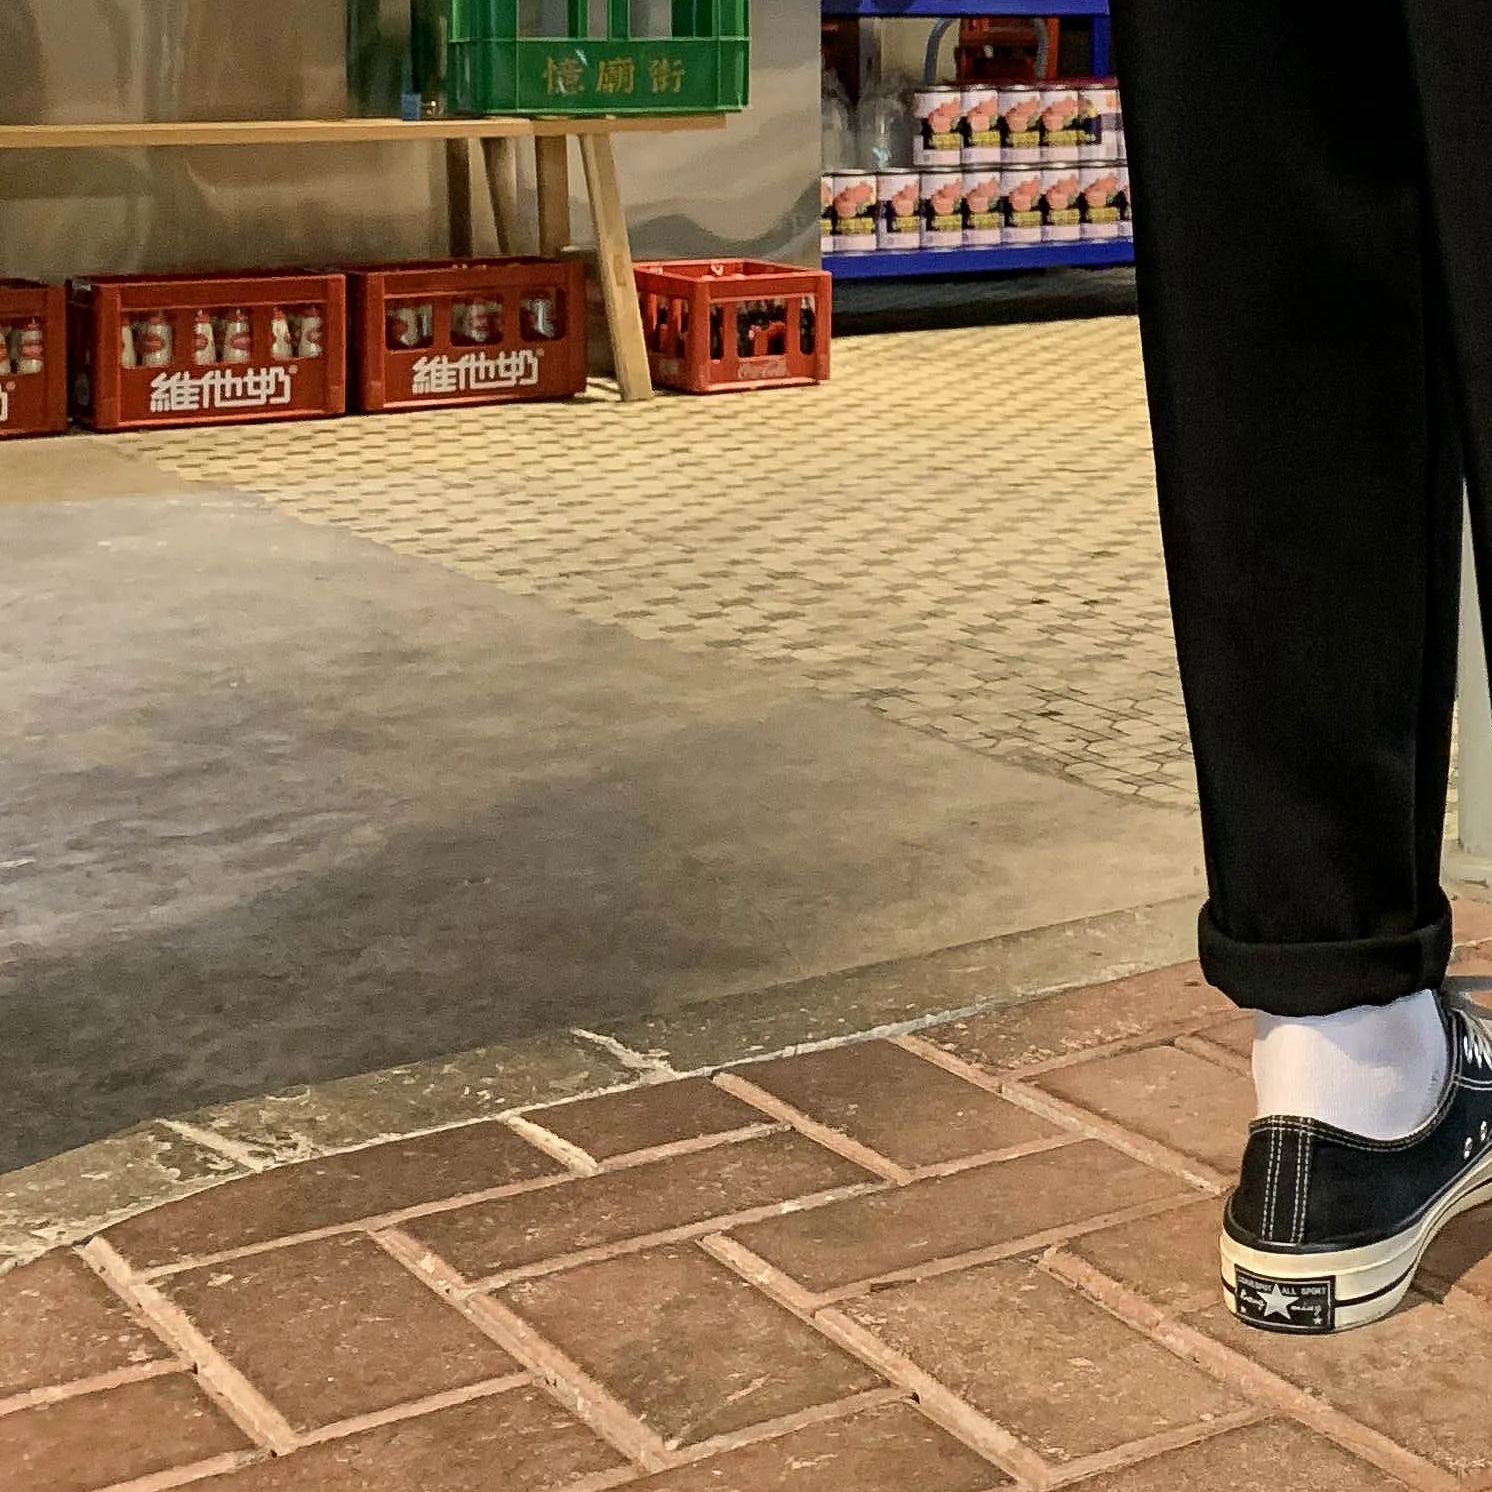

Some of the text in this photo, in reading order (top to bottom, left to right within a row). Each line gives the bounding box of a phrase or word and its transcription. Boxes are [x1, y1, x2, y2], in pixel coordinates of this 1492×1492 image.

[150, 366, 291, 413] 維他奶
[412, 349, 538, 395] 維他奶
